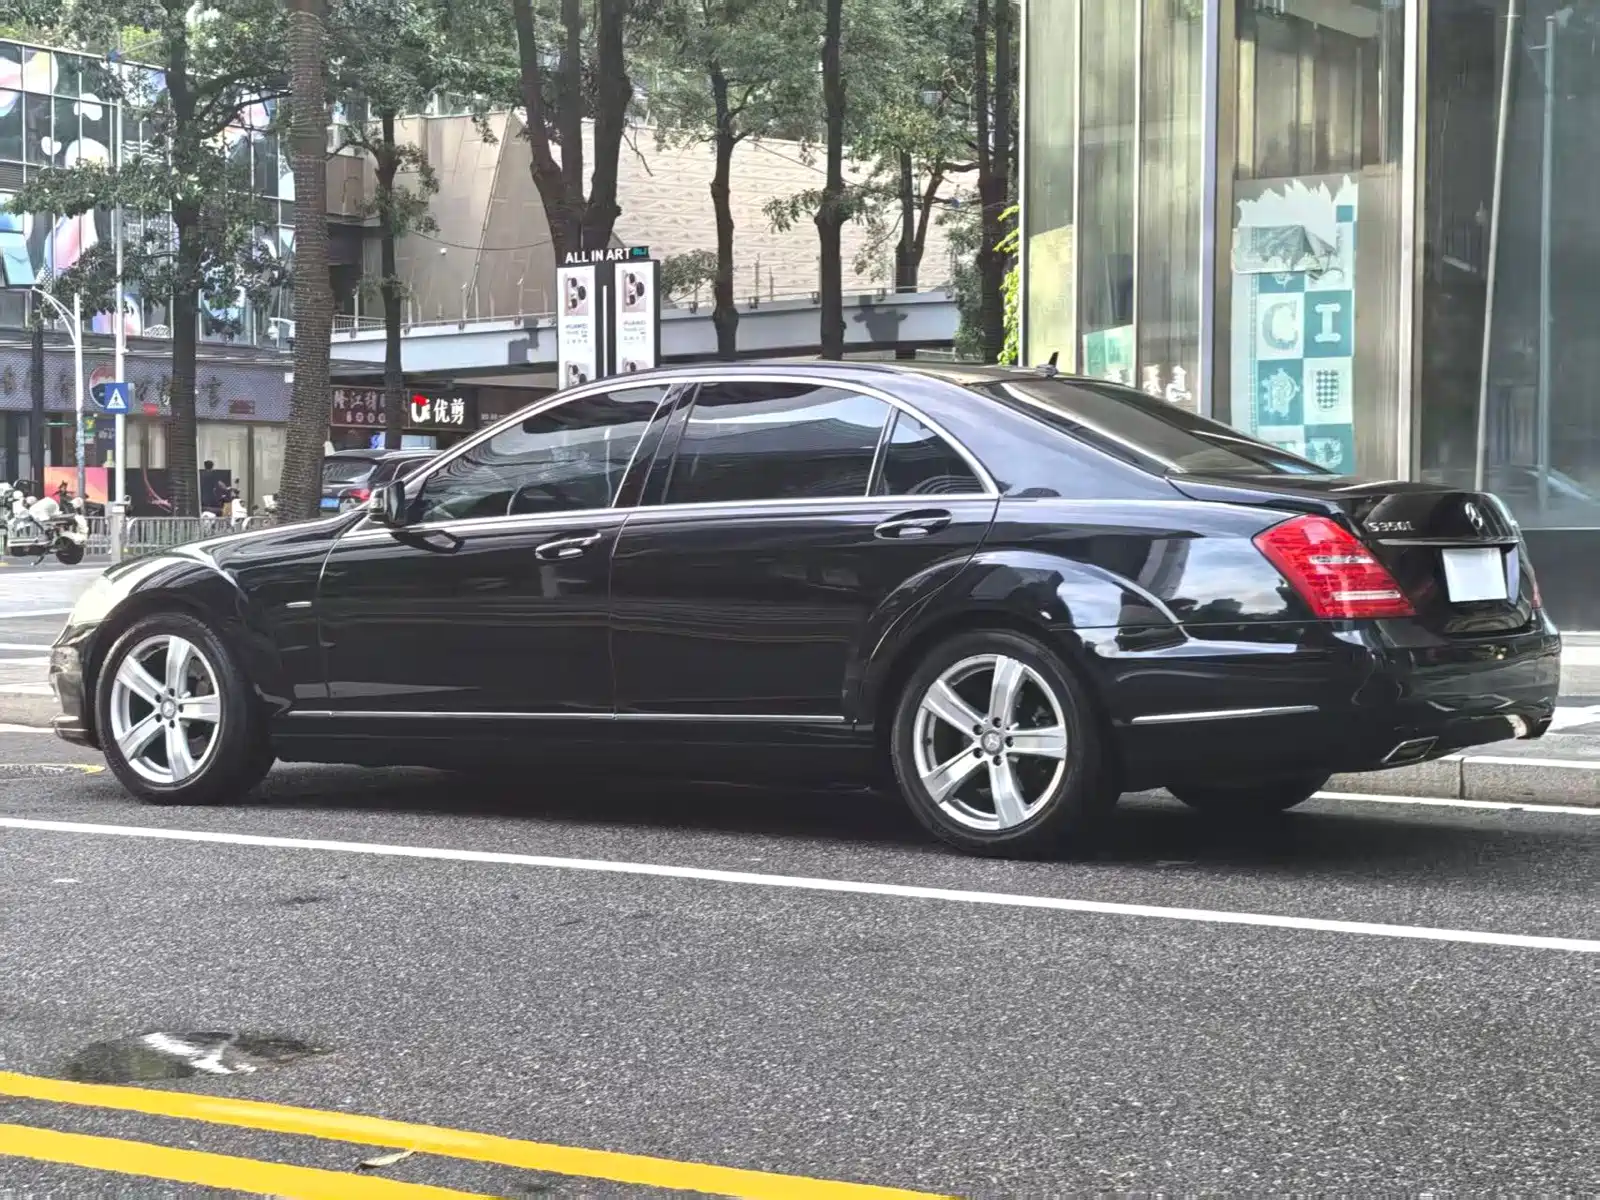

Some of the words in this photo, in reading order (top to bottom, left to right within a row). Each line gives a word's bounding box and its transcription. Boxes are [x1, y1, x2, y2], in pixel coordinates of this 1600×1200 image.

[565, 251, 589, 264] ALL
[591, 249, 604, 262] IN
[606, 247, 631, 261] ART
[433, 398, 465, 425] 优剪
[1368, 521, 1416, 532] S350L
